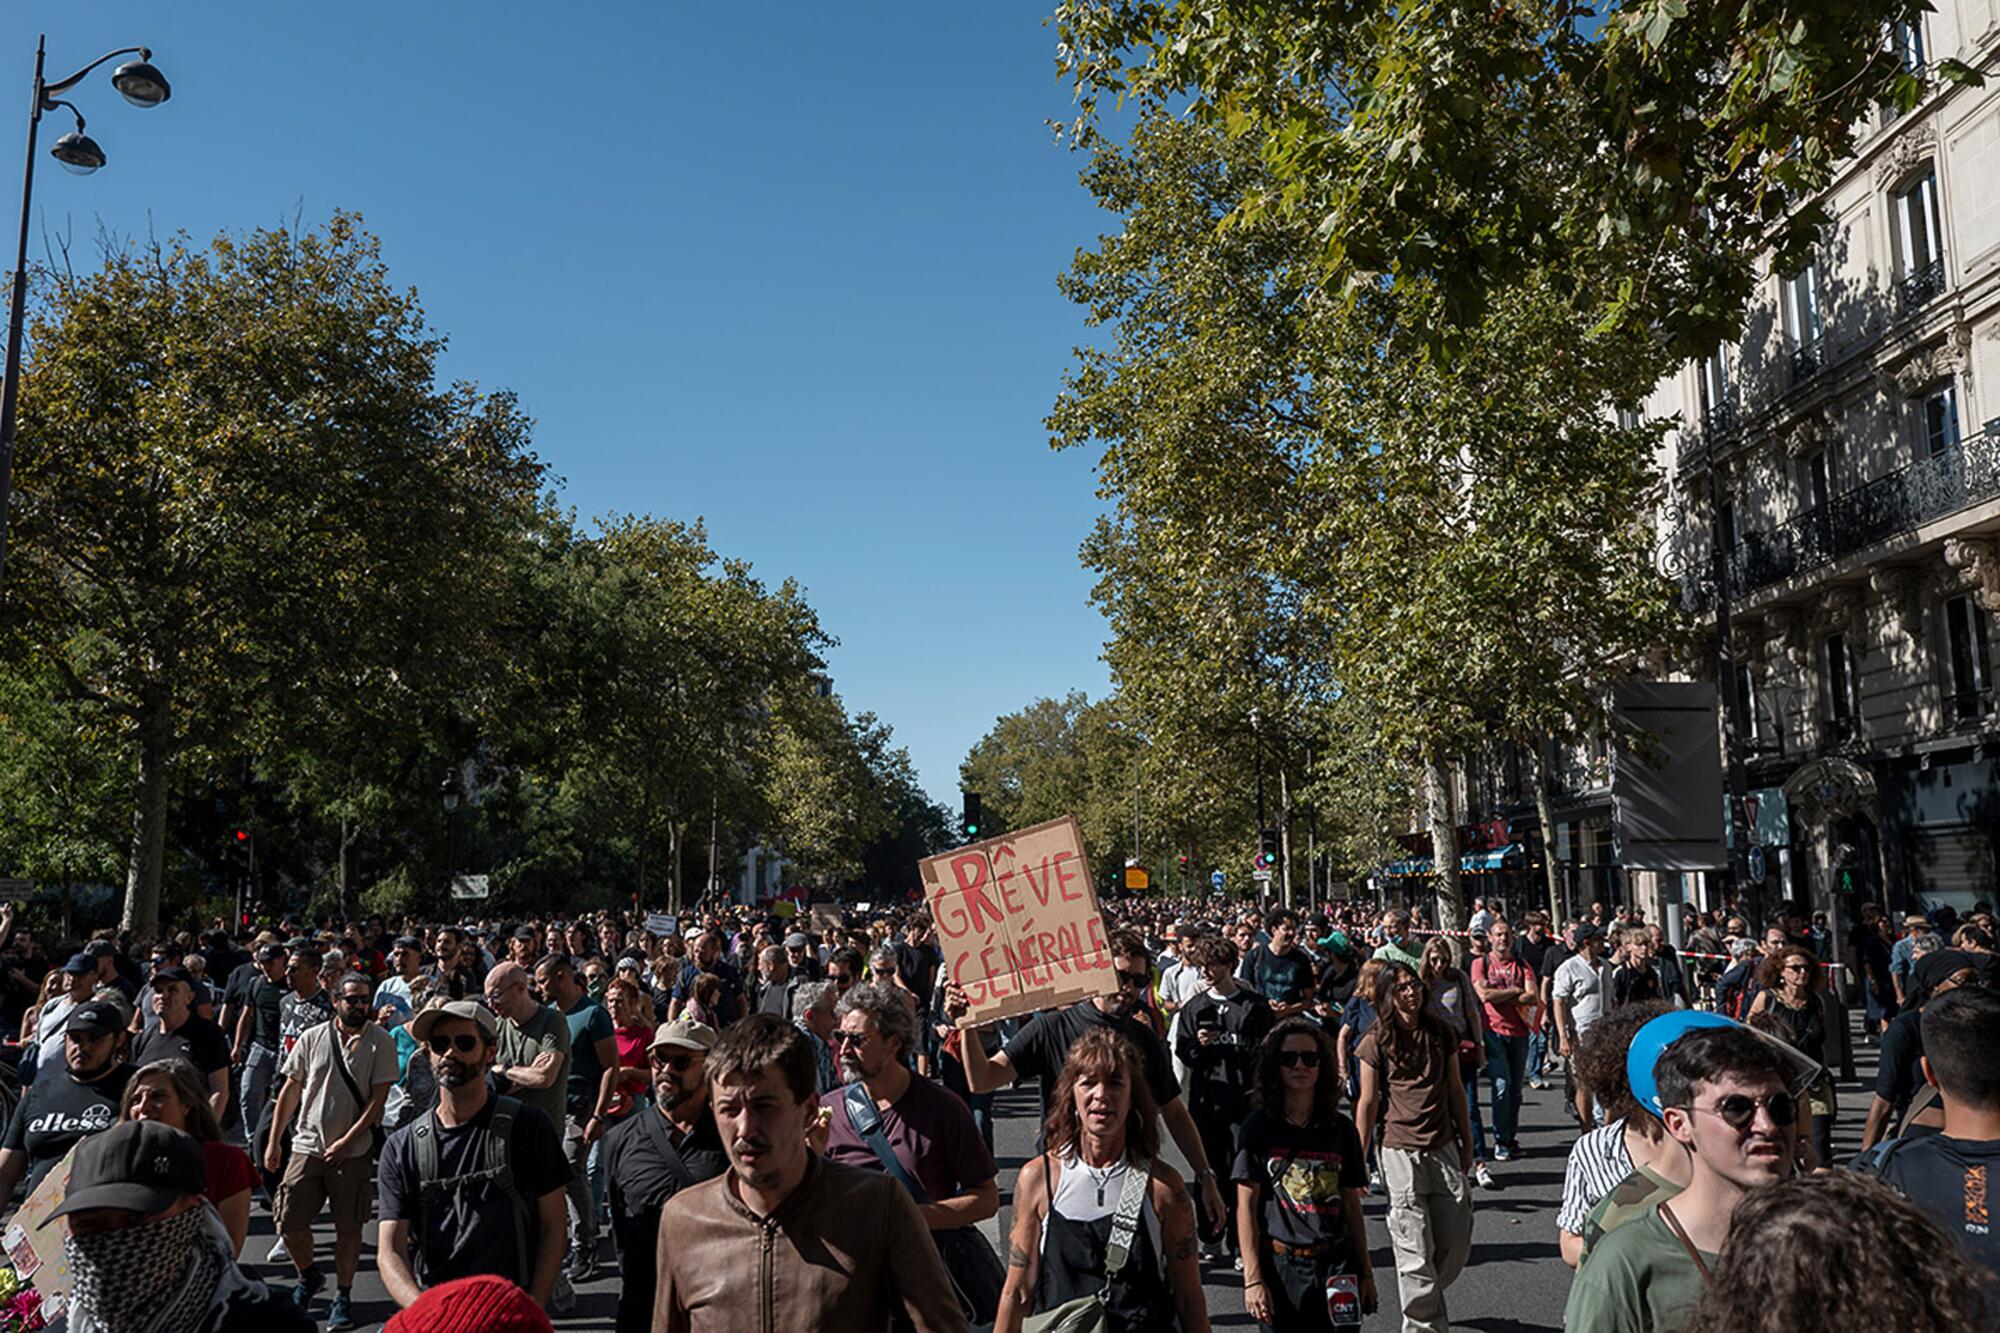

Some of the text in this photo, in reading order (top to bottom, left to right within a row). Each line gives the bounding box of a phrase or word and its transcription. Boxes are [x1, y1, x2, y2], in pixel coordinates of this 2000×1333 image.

[933, 846, 1083, 939] GRÊVE
[954, 917, 1112, 1006] GÉNÉRALE
[28, 1112, 111, 1132] elless
